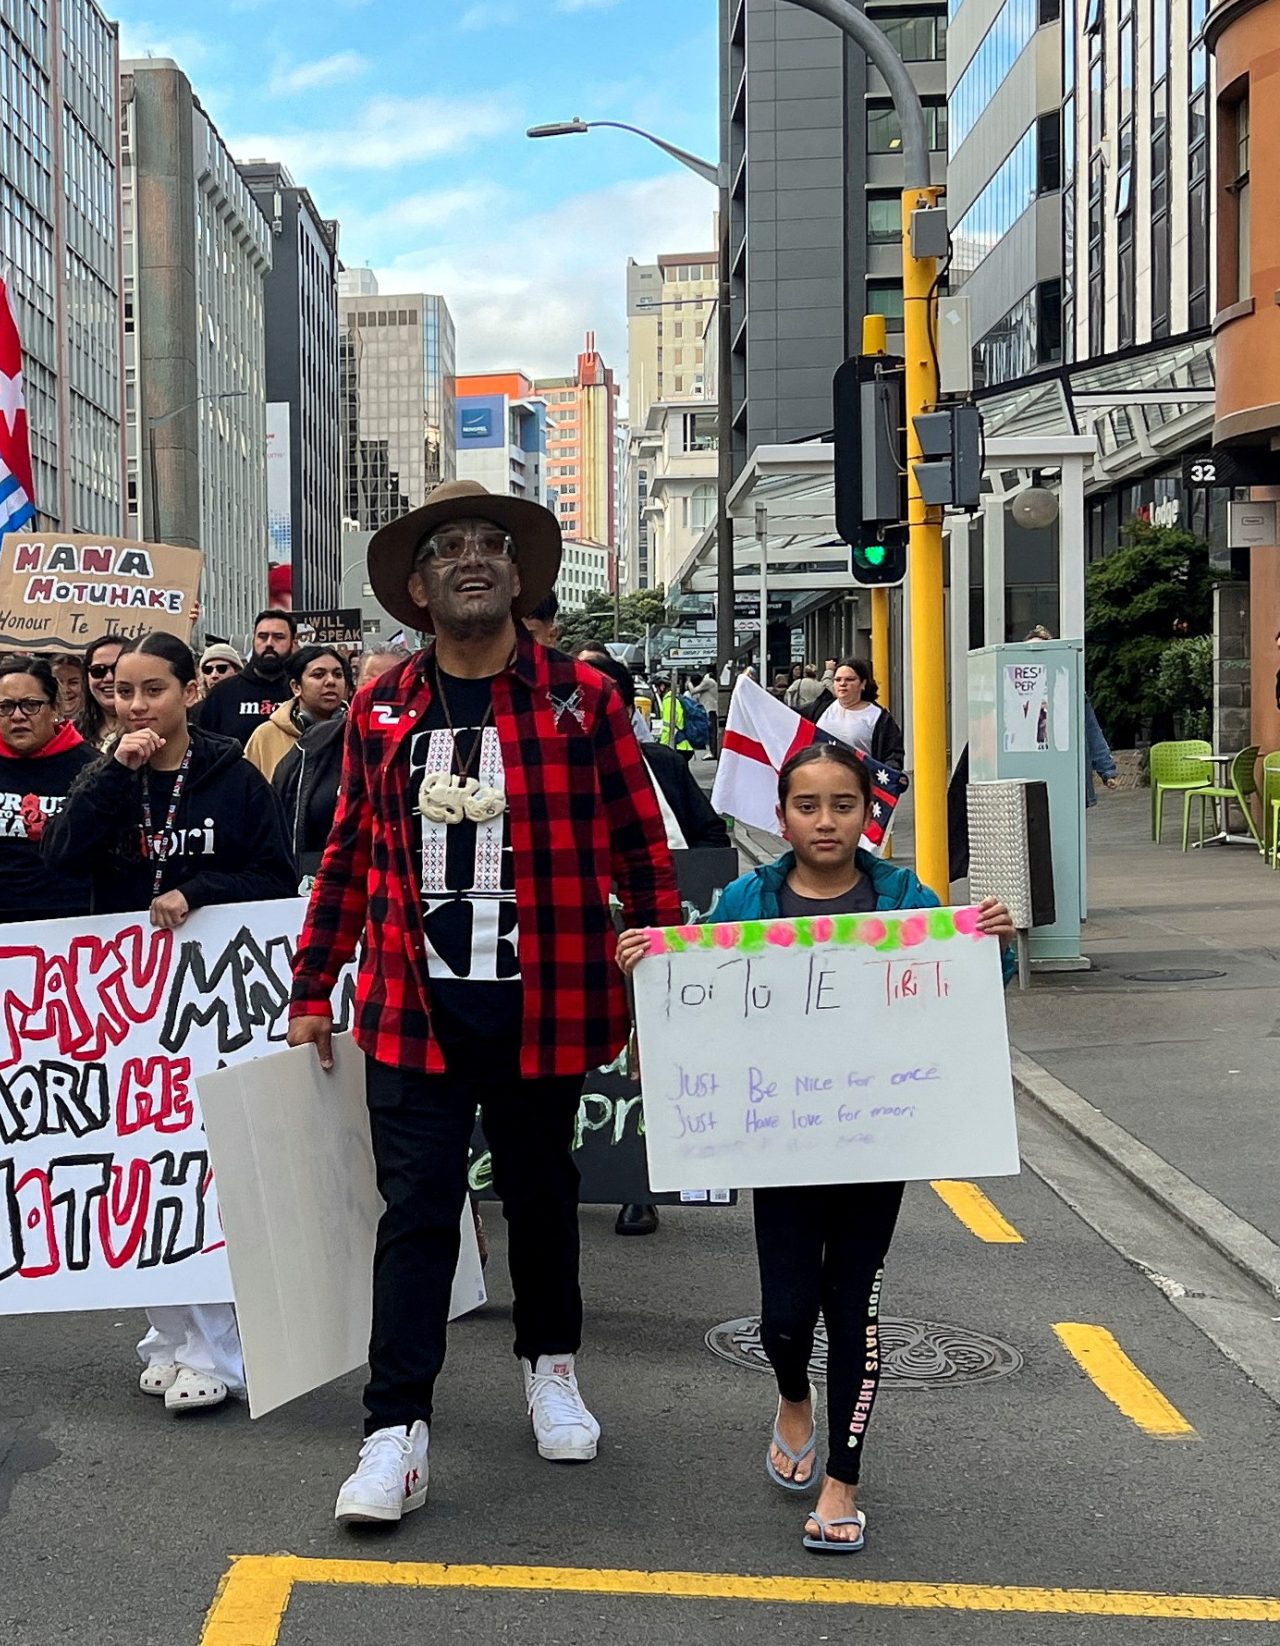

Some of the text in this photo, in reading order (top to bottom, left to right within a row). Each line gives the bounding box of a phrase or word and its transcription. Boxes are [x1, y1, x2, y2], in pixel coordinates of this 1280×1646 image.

[1190, 464, 1216, 482] 32
[14, 543, 154, 579] MANA
[70, 613, 89, 634] Te
[308, 616, 345, 628] WILL
[318, 629, 361, 642] SPEAK
[800, 949, 850, 1015] TE
[748, 1066, 778, 1103] Be
[745, 1108, 779, 1133] Have
[792, 1110, 823, 1128] love
[865, 1324, 879, 1373] DAYS
[848, 1378, 876, 1434] AHEAD
